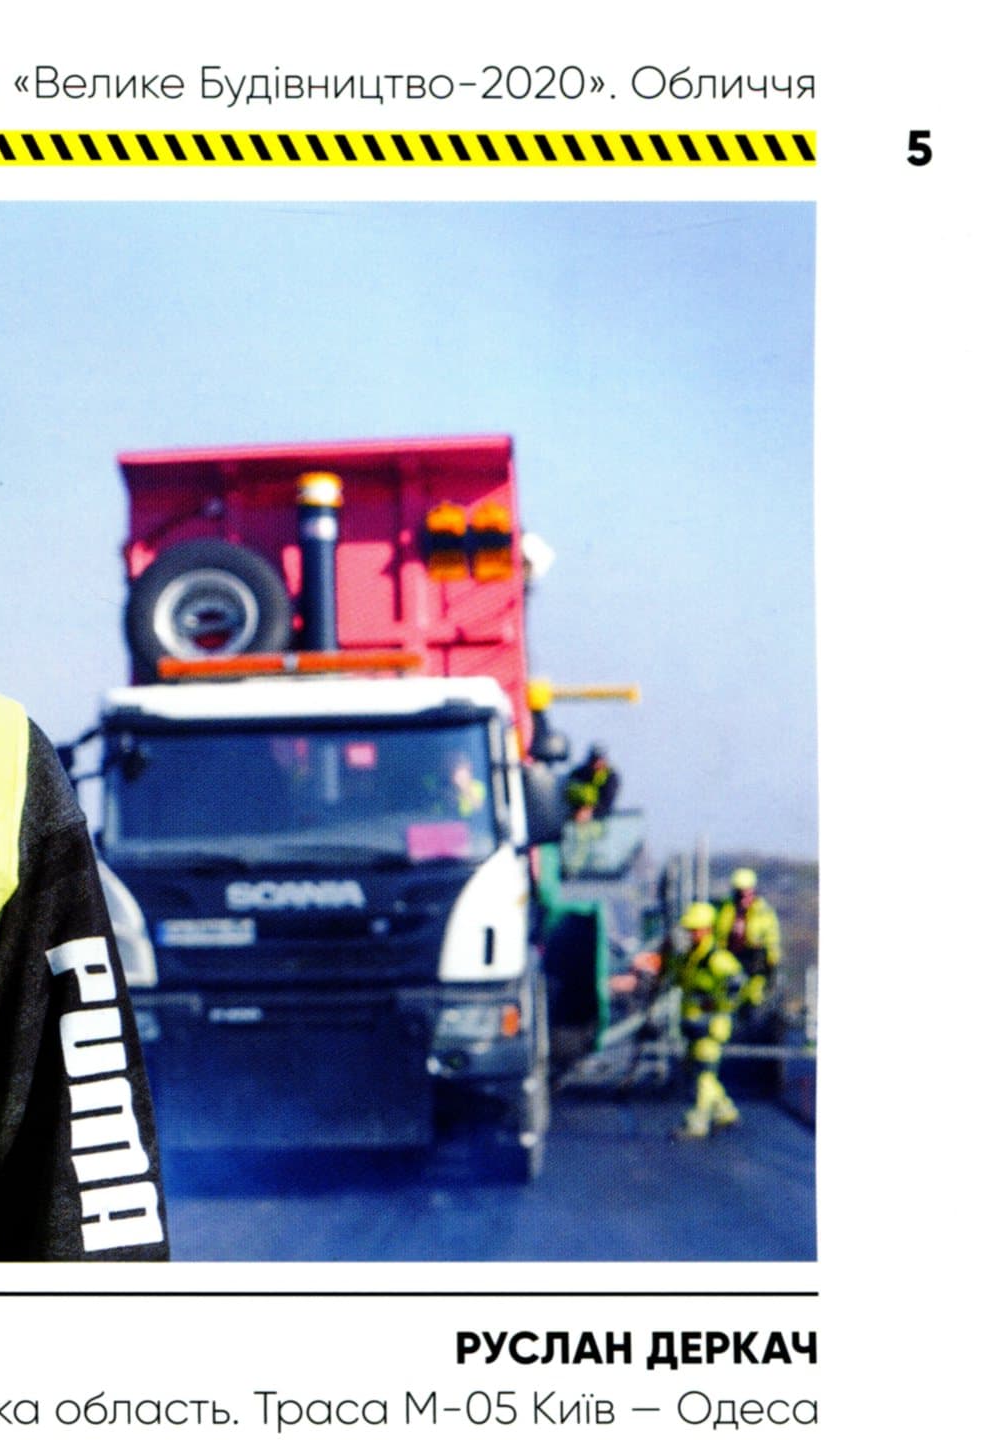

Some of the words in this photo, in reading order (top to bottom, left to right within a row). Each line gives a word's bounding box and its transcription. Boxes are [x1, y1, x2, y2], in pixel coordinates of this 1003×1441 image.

[15, 66, 184, 99] «Велике
[632, 66, 814, 99] Обличчя
[907, 130, 932, 166] 5
[225, 880, 366, 911] SCANIA
[45, 936, 164, 1252] PUMA
[457, 1331, 631, 1364] РУСЛАН
[647, 1332, 817, 1370] ДЕРКАЧ
[56, 1392, 238, 1424] область.
[254, 1391, 387, 1433] Траса
[534, 1392, 614, 1424] Київ
[678, 1391, 817, 1429] Одеса
